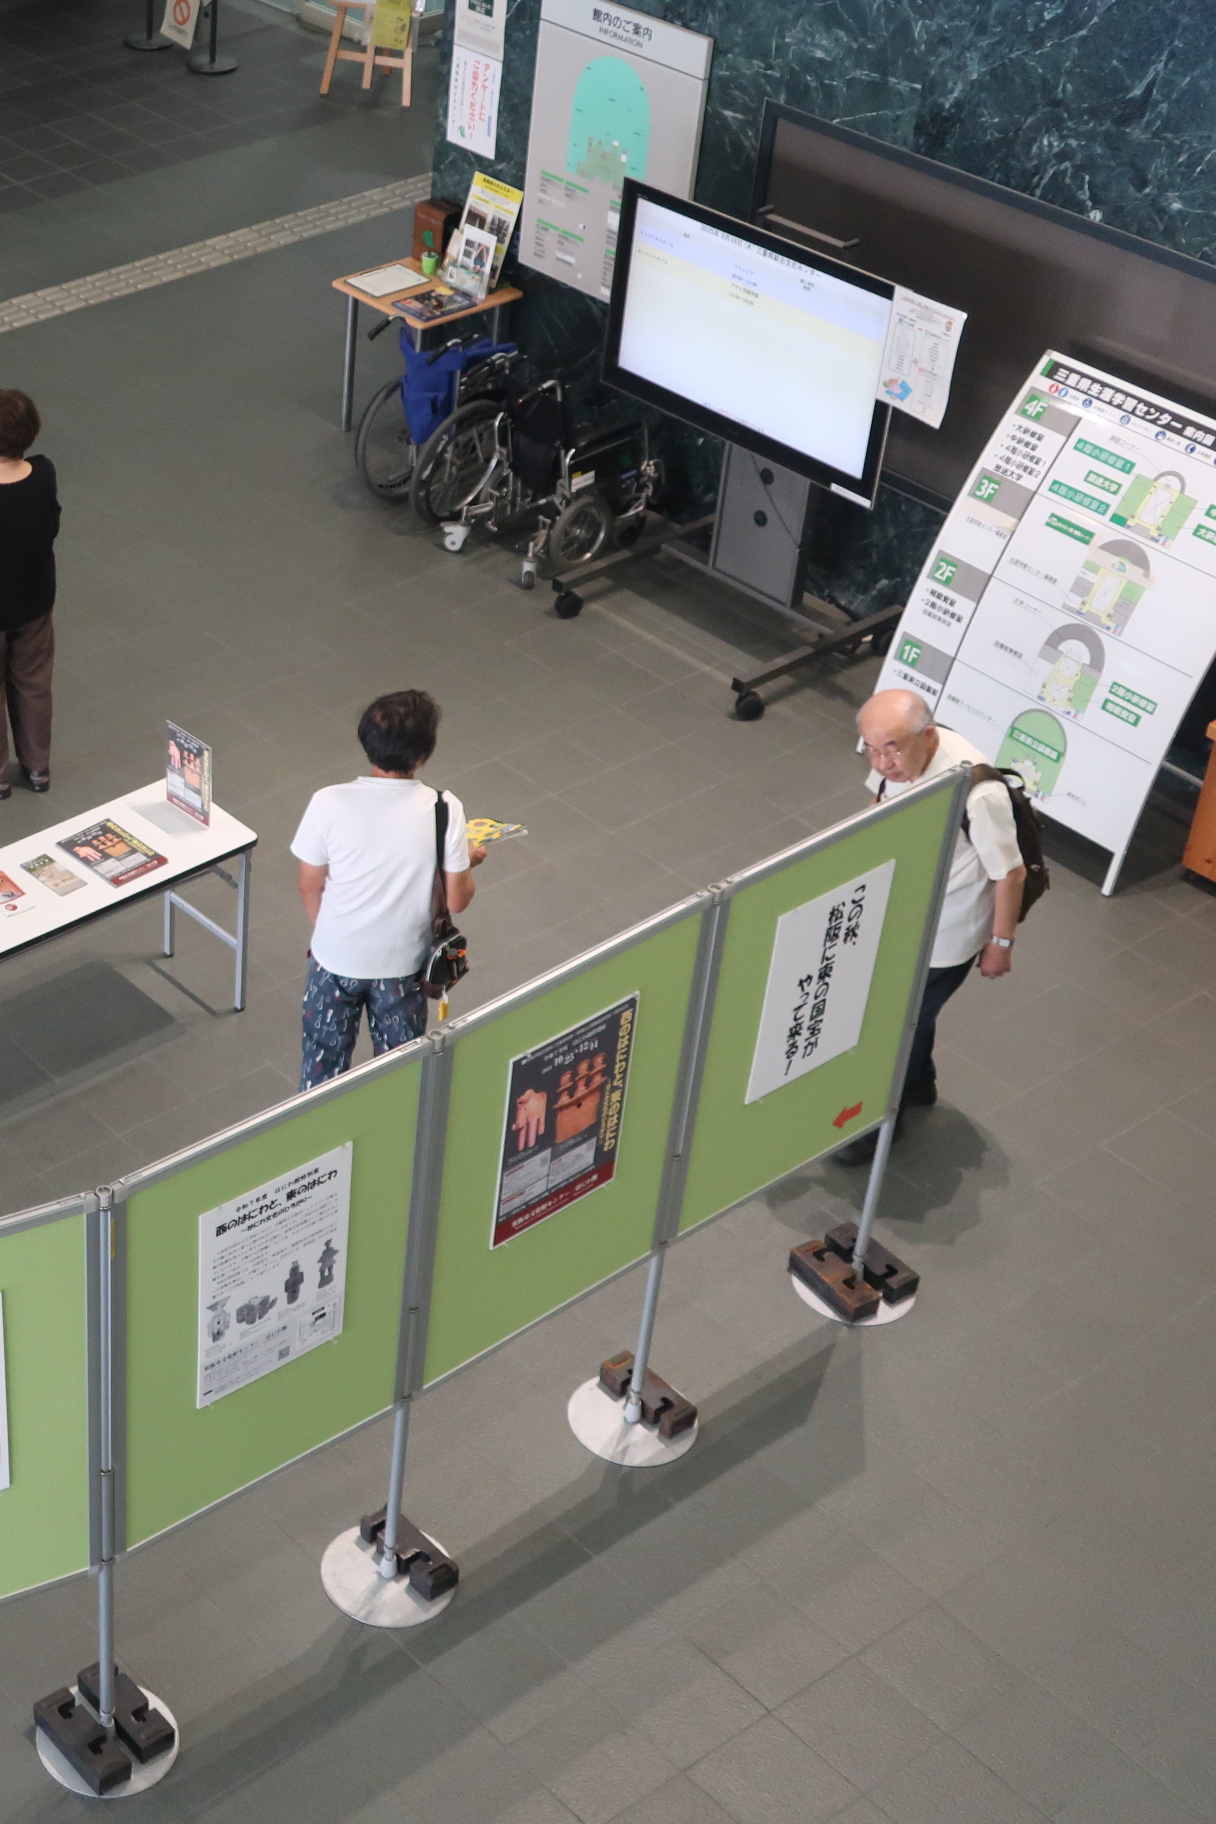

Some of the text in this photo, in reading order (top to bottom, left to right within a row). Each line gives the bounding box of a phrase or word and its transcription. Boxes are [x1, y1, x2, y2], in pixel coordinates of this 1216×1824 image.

[592, 7, 653, 42] 館内のご案内
[598, 26, 644, 49] INFORMATION
[479, 62, 491, 123] アンケートに
[1024, 399, 1049, 417] 4F
[1053, 367, 1216, 447] 三重県生涯学習センター 案内図
[1010, 434, 1040, 451] 中研修室
[1015, 424, 1046, 442] 大研修室
[999, 454, 1042, 478] 4階小研修室2
[1076, 438, 1131, 472] 4階小研修室1
[993, 464, 1024, 482] 放送大学
[1088, 472, 1120, 493] 放送大学
[974, 479, 1000, 498] 3F
[1050, 482, 1107, 513] 4階小研修室2
[934, 561, 957, 582] 2F
[903, 644, 922, 663] 1F
[896, 669, 939, 697] 三重県立図書館
[1111, 684, 1156, 712] 2階小研修室
[843, 883, 867, 946] この秋、
[802, 901, 847, 1059] 松阪に東の国宝が
[215, 1168, 338, 1238] 西のはにわと、東のはにわ
